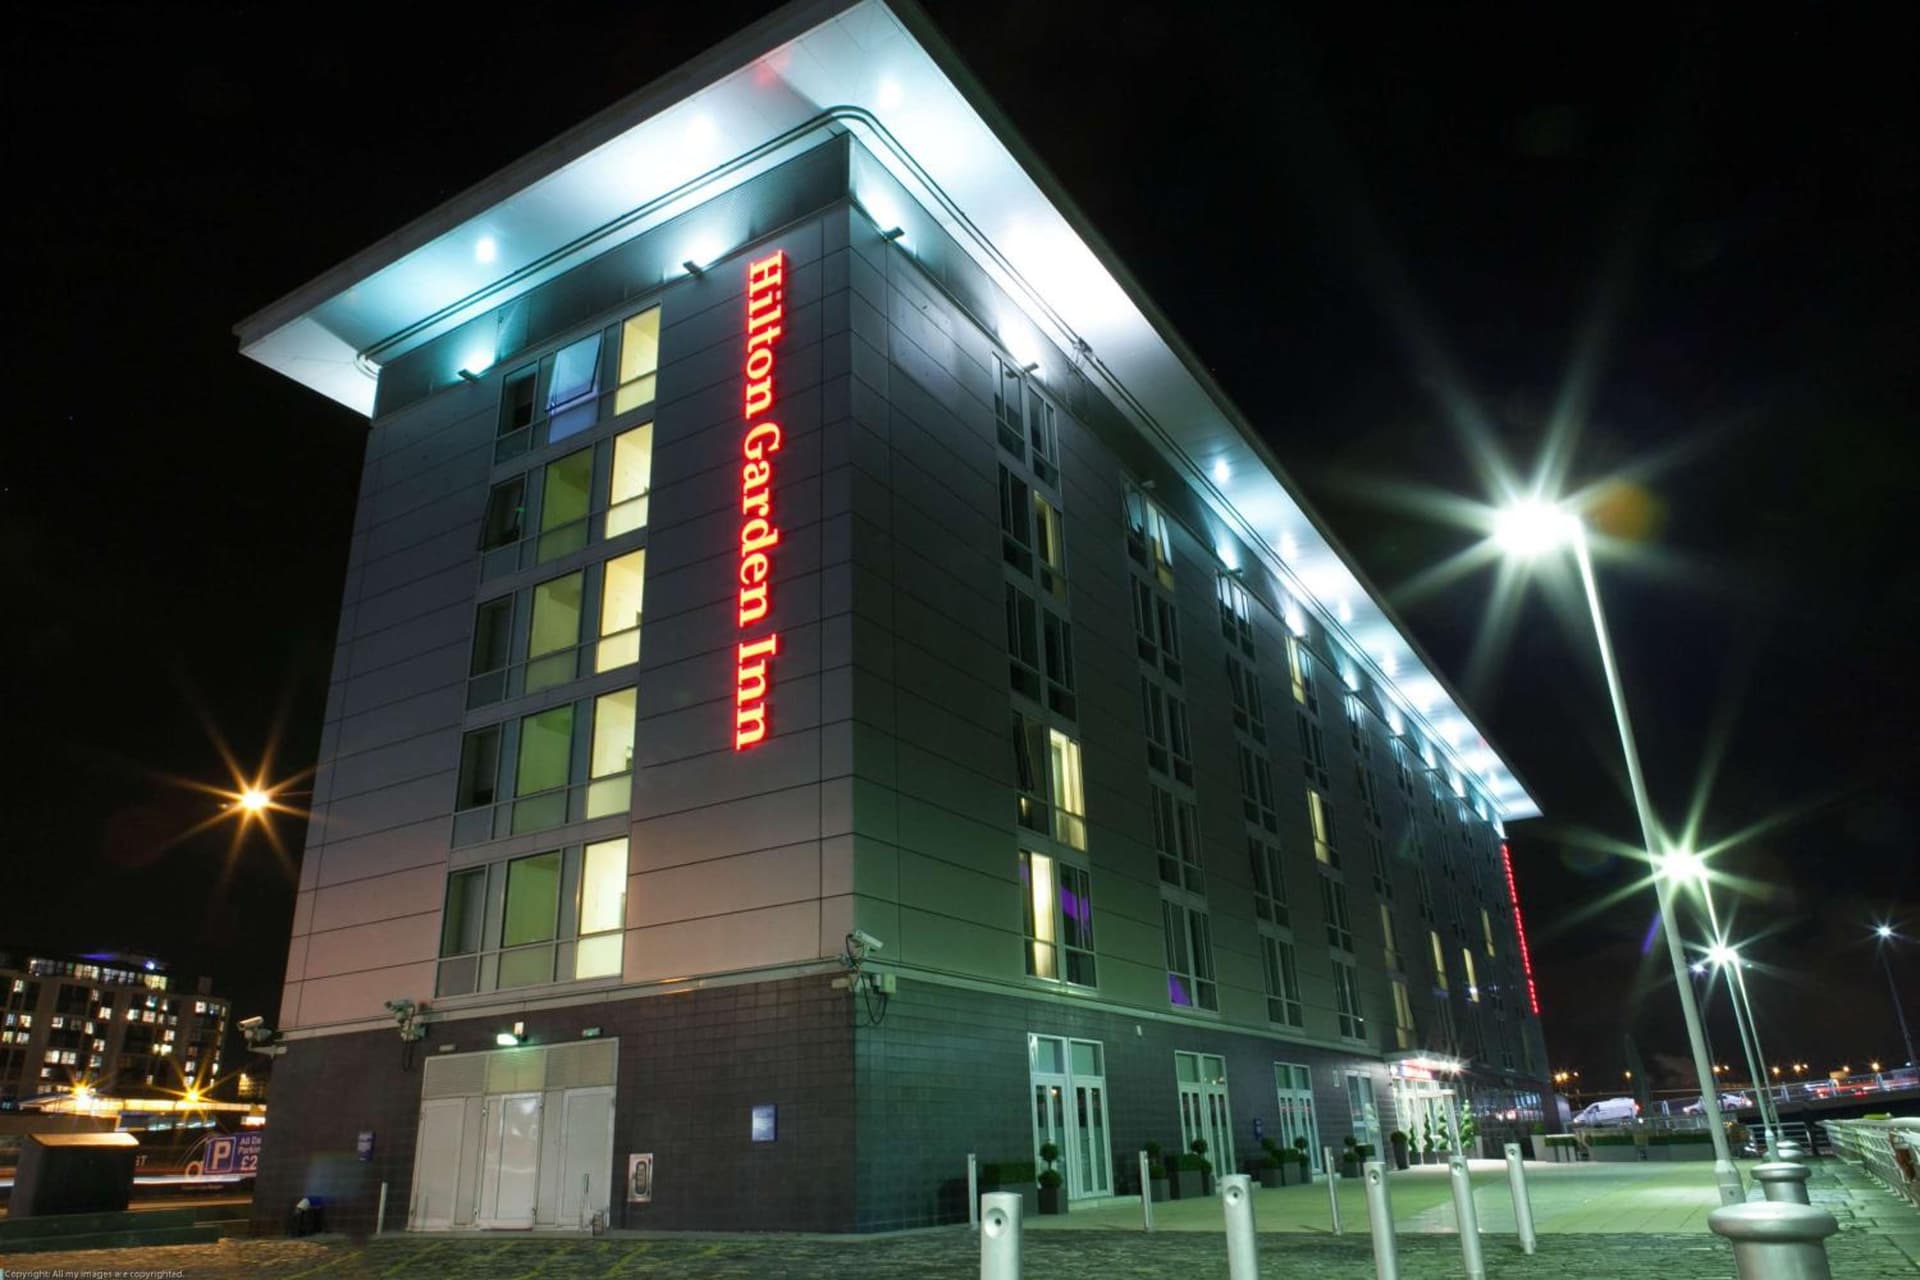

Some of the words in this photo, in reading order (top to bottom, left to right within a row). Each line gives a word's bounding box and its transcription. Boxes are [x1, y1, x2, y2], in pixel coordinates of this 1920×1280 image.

[744, 248, 784, 421] Hilton
[739, 421, 781, 628] Garden
[735, 633, 777, 751] Inn
[211, 1140, 232, 1170] P
[238, 1145, 261, 1155] Parkin
